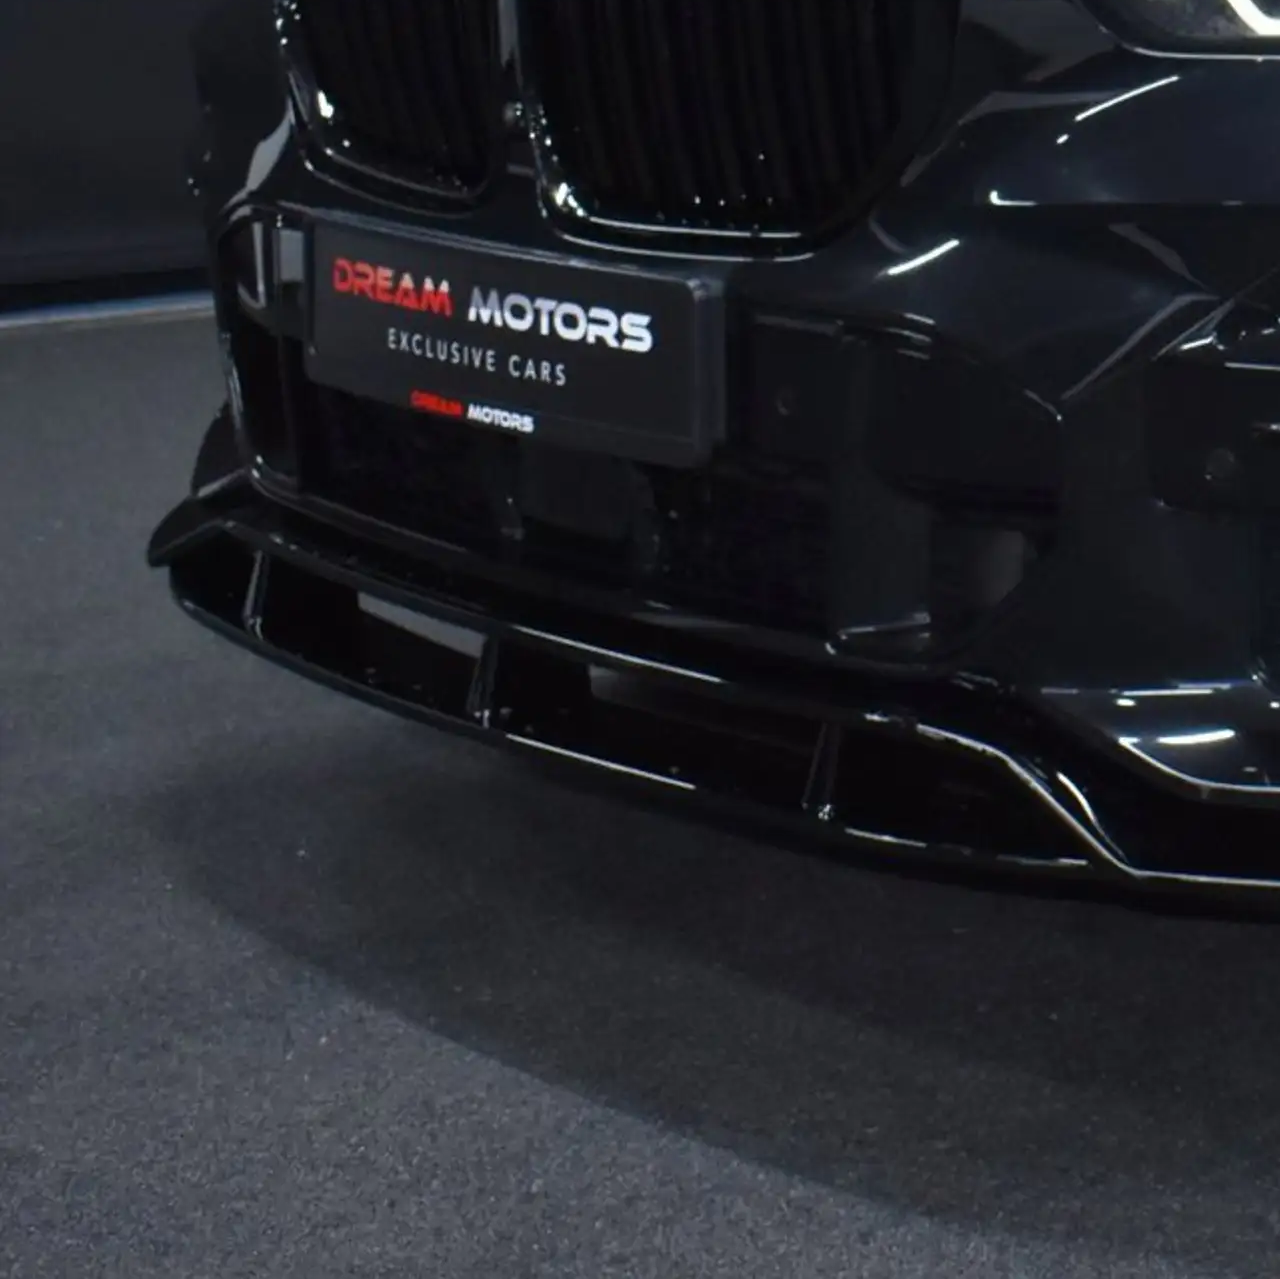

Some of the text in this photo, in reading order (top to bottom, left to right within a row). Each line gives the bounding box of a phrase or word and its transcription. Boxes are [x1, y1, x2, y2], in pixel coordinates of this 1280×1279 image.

[333, 257, 654, 354] DREAM MOTORS
[388, 327, 566, 386] EXCLUSIVE CARS
[467, 403, 535, 433] MOTORS
